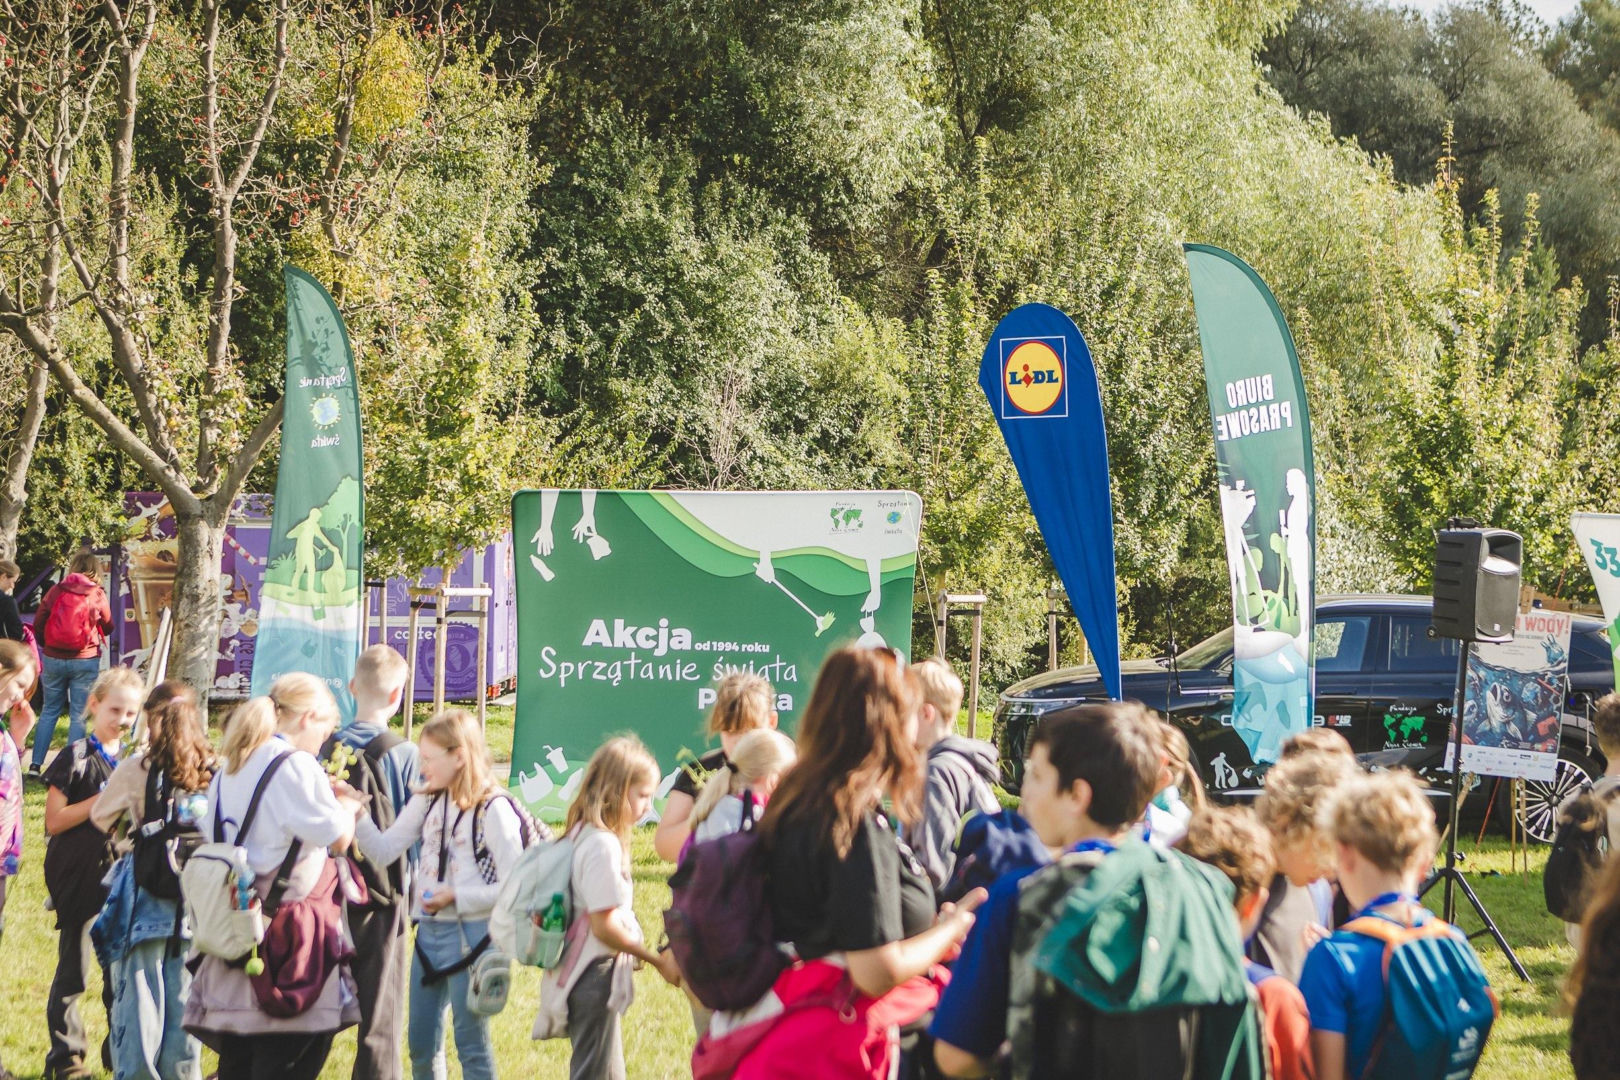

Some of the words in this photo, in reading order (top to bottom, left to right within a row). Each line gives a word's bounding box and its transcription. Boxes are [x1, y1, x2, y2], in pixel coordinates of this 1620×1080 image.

[582, 618, 692, 656] Akcja
[694, 641, 710, 651] od
[712, 641, 738, 652] 1994
[741, 642, 770, 653] roku
[539, 646, 701, 688] Sprzątanie
